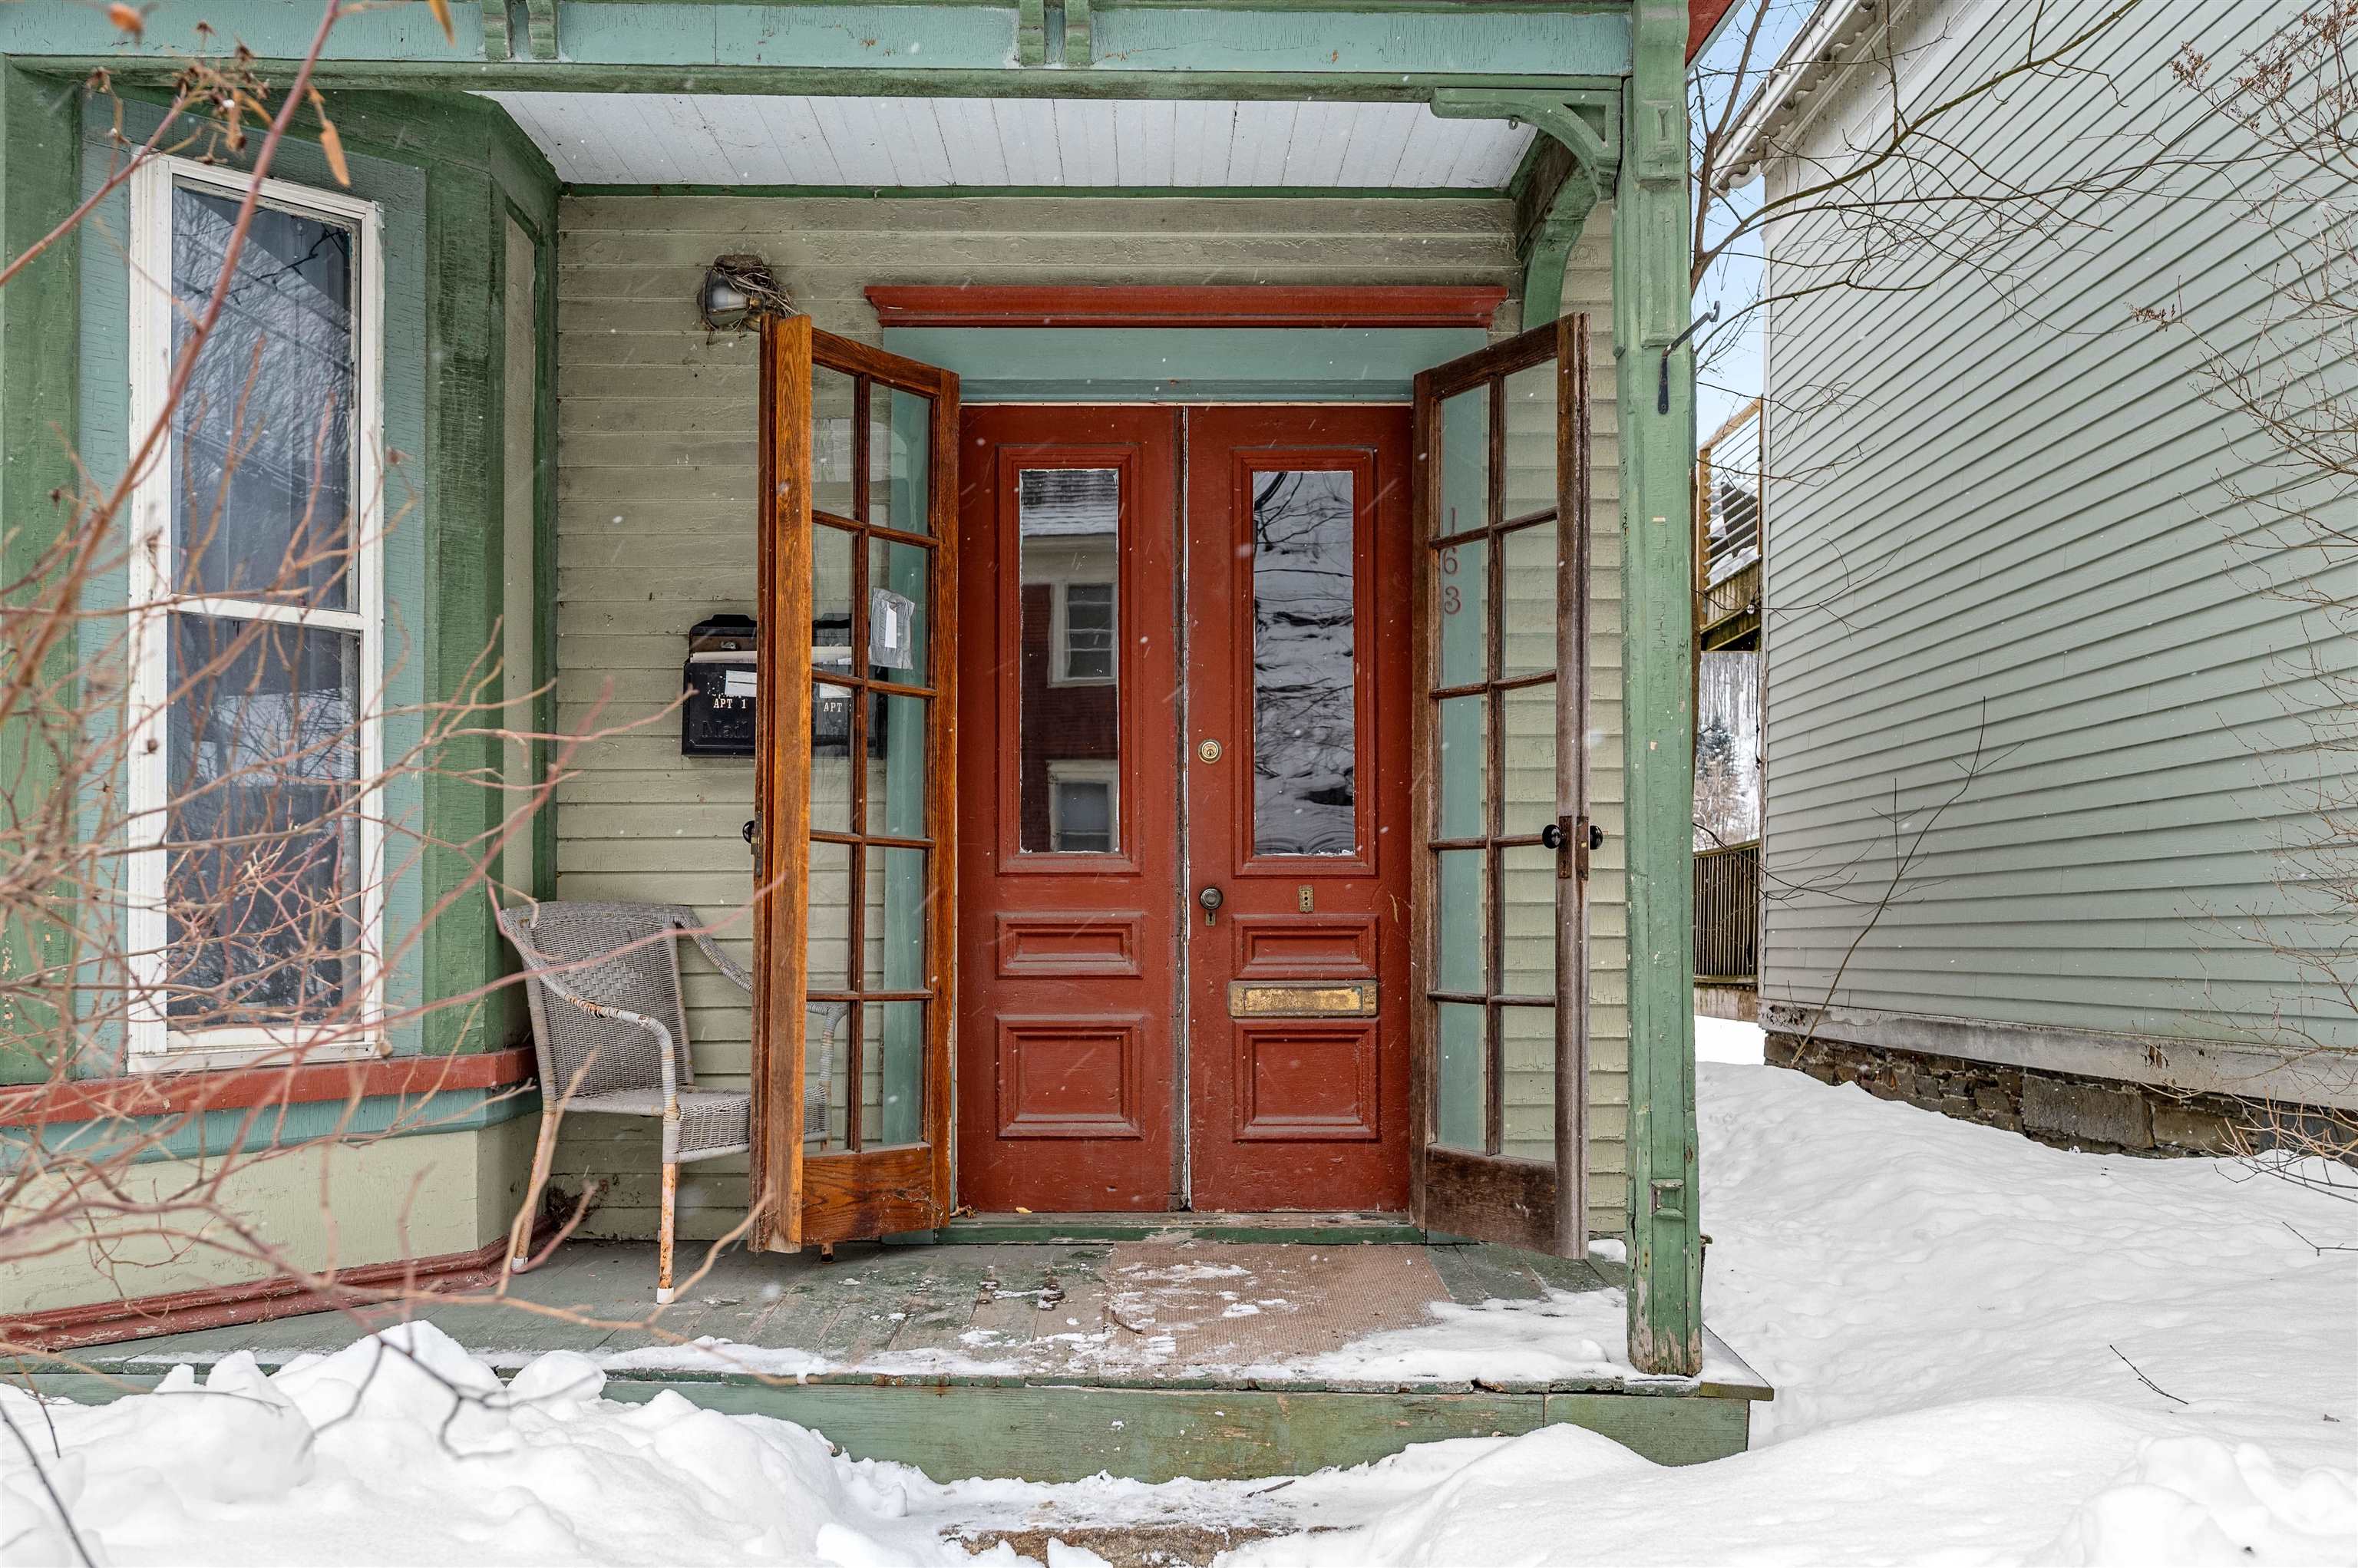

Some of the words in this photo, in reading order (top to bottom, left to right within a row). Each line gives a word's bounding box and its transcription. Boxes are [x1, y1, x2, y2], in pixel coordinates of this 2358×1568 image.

[713, 698, 733, 708] APT
[741, 698, 747, 709] 1
[823, 701, 843, 712] APT
